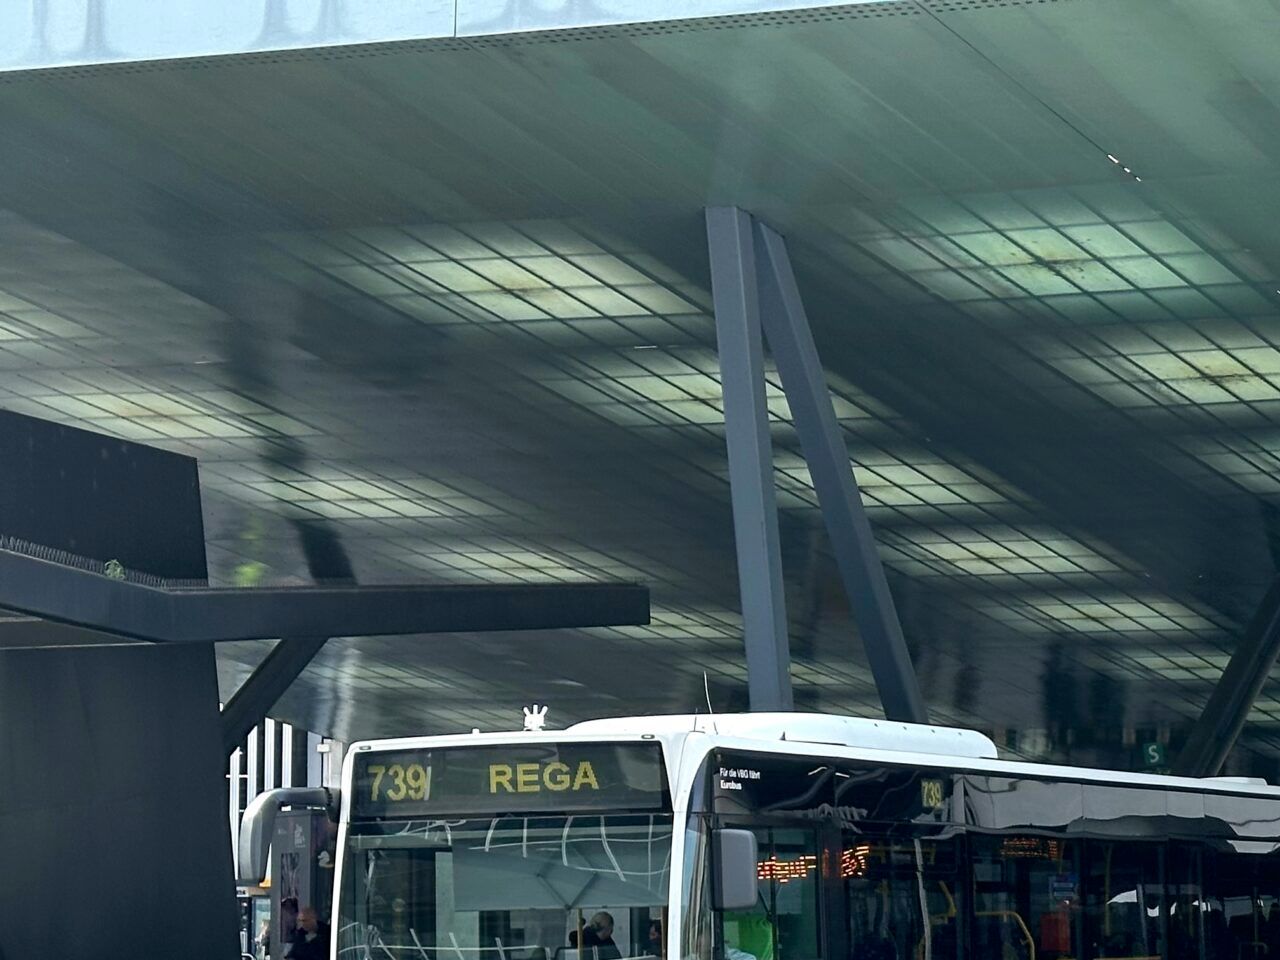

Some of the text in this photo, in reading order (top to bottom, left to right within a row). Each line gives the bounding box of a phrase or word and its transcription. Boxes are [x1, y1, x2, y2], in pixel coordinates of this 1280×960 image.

[1148, 744, 1160, 763] S
[367, 761, 600, 801] 739 REGA
